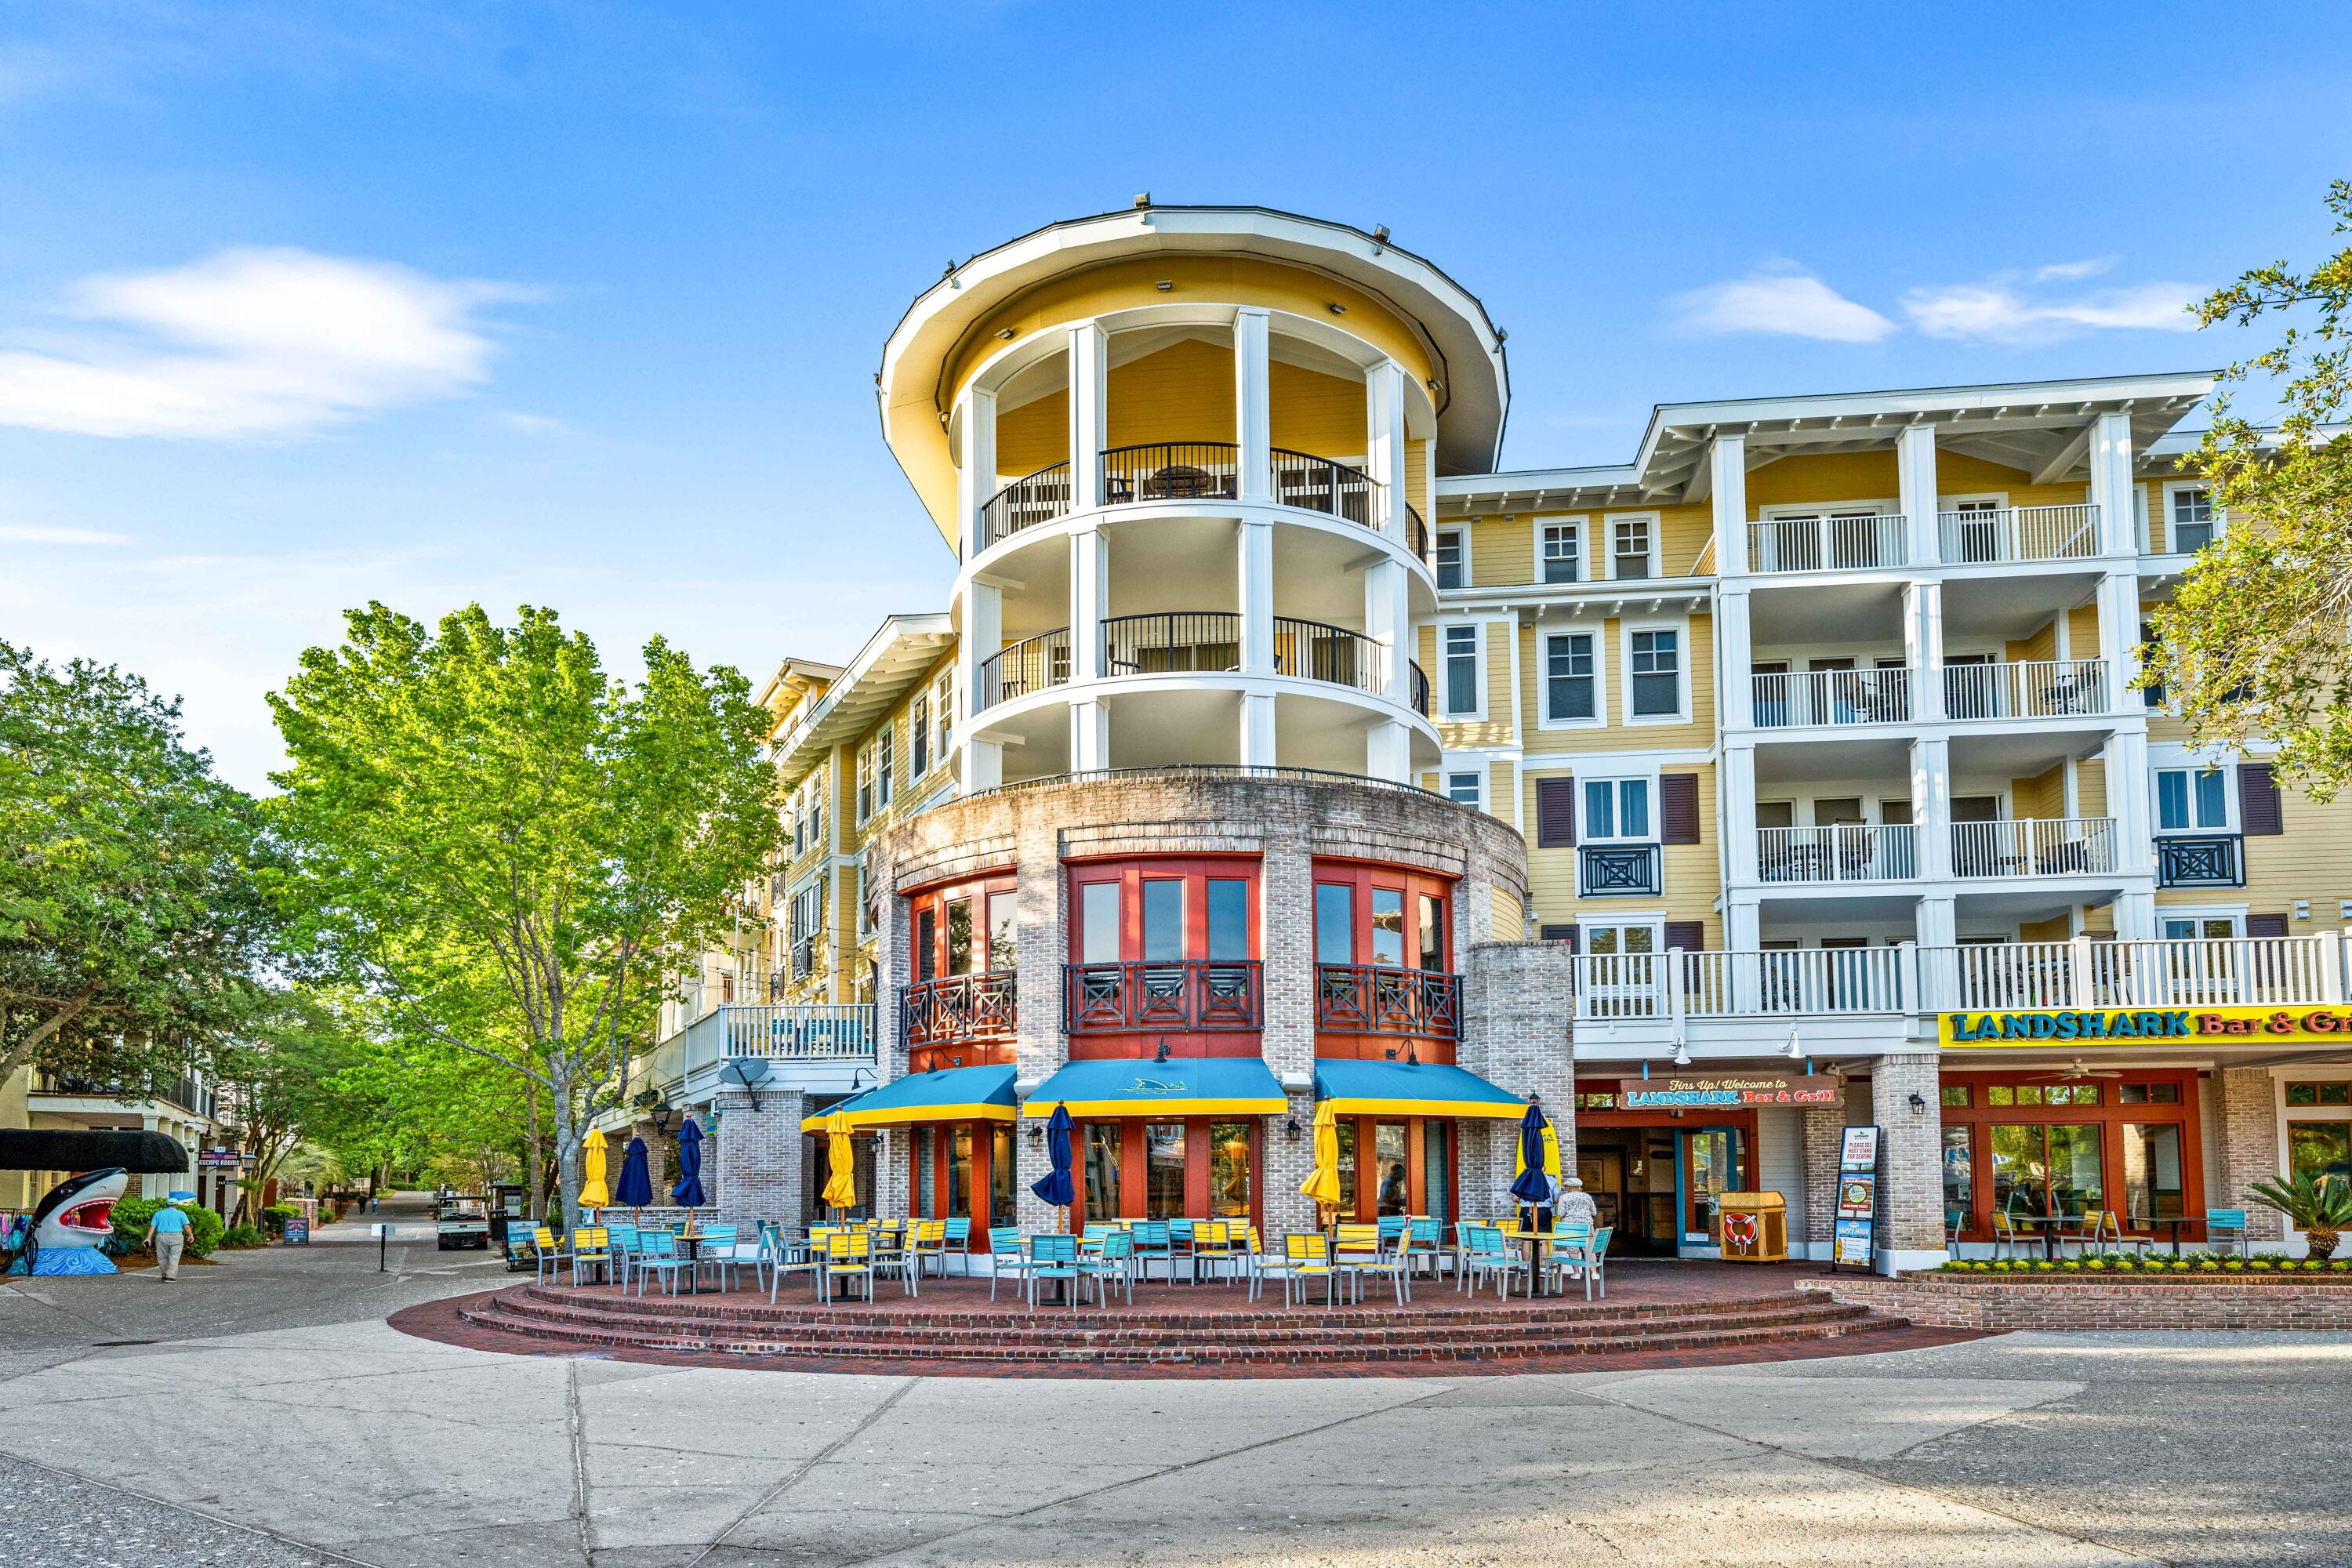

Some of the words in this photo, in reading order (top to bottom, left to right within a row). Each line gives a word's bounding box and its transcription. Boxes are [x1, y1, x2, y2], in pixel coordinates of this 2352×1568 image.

[1951, 1011, 2190, 1041] LANDSHARK
[2195, 1014, 2262, 1034] Bar
[2265, 1012, 2298, 1033] &
[2301, 1011, 2352, 1033] Gr
[1669, 1080, 1694, 1091] Fins
[1697, 1080, 1720, 1091] Up!
[1722, 1079, 1773, 1089] Welcome
[1775, 1079, 1788, 1088] to
[1628, 1091, 1741, 1106] LANDSHARK
[1743, 1091, 1773, 1102] Bar
[1776, 1091, 1791, 1102] &
[1794, 1090, 1835, 1102] Grill
